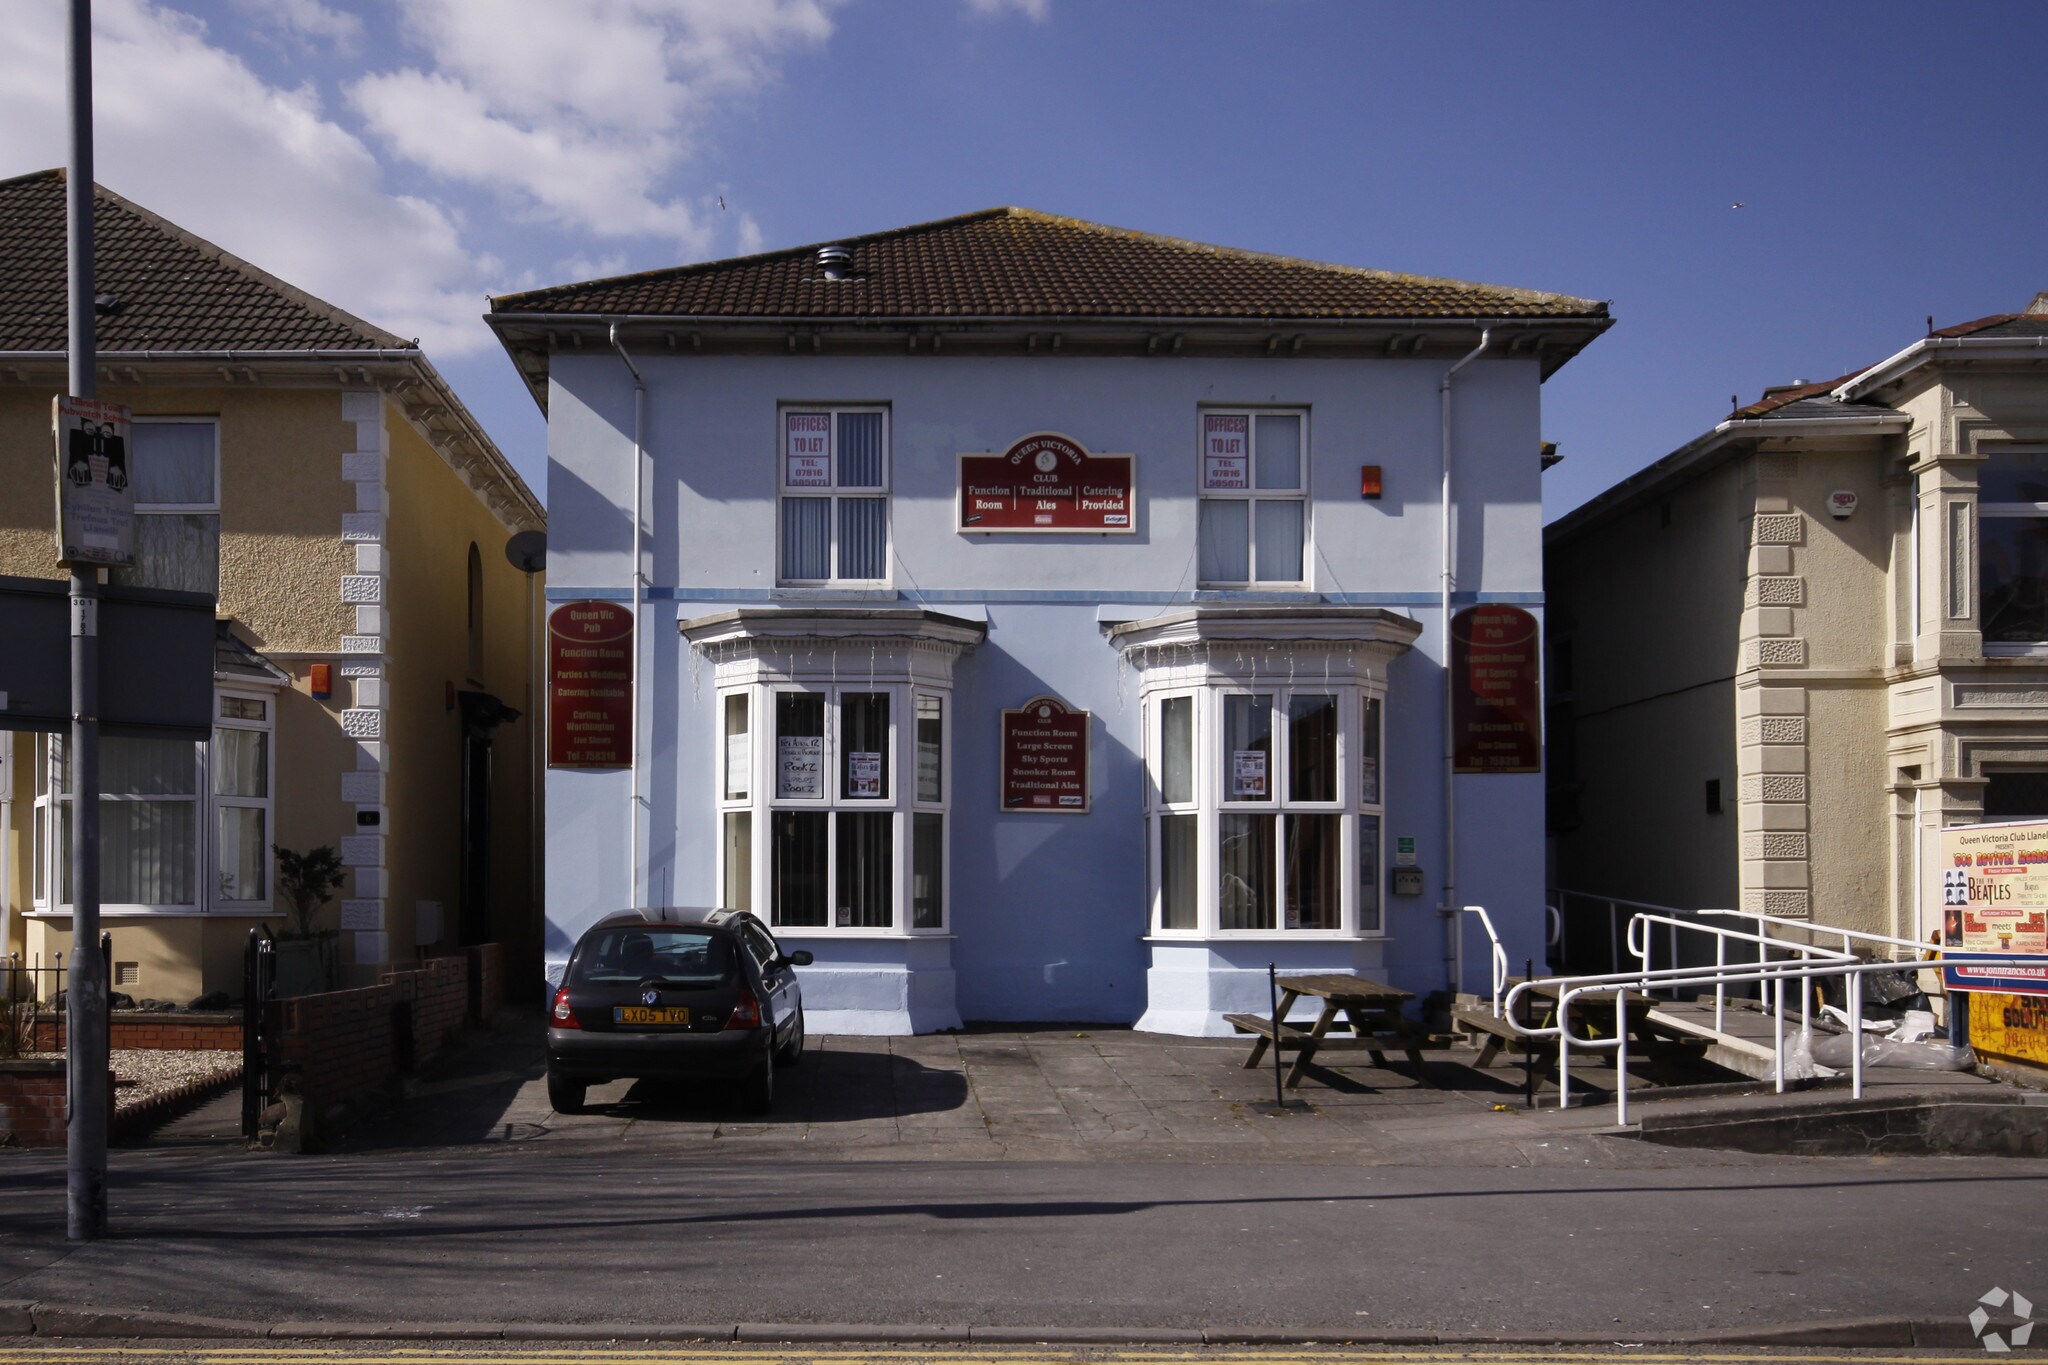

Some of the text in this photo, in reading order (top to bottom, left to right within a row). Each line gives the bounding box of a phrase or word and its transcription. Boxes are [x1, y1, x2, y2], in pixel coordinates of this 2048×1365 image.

[790, 416, 828, 432] OFFICES
[1207, 417, 1245, 433] OFFICES
[794, 437, 824, 452] TO LET
[1211, 438, 1241, 453] TO LET
[1011, 440, 1082, 466] QUEEN VICTORIA
[1033, 474, 1058, 483] CLUB
[968, 485, 1011, 496] Function
[1019, 486, 1073, 496] Traditional
[1083, 486, 1124, 499] Catering
[975, 500, 1003, 510] Room
[1036, 500, 1057, 510] Ales
[1082, 500, 1124, 511] Provided
[570, 610, 615, 620] Queen Vic
[584, 623, 601, 633] Pub
[560, 648, 625, 658] Function Room
[557, 671, 583, 679] Parties
[558, 688, 590, 697] Catering
[1012, 729, 1078, 737] Function Room
[1017, 742, 1042, 751] Large
[1022, 755, 1068, 764] Sky Sports
[1013, 768, 1076, 776] Snooker Room
[1010, 781, 1080, 789] Traditional Ales
[1960, 836, 1981, 845] Queen
[1981, 833, 2008, 843] Victoria
[2010, 832, 2026, 842] Club
[1968, 876, 2011, 905] BEATLES
[622, 1009, 656, 1022] LX05
